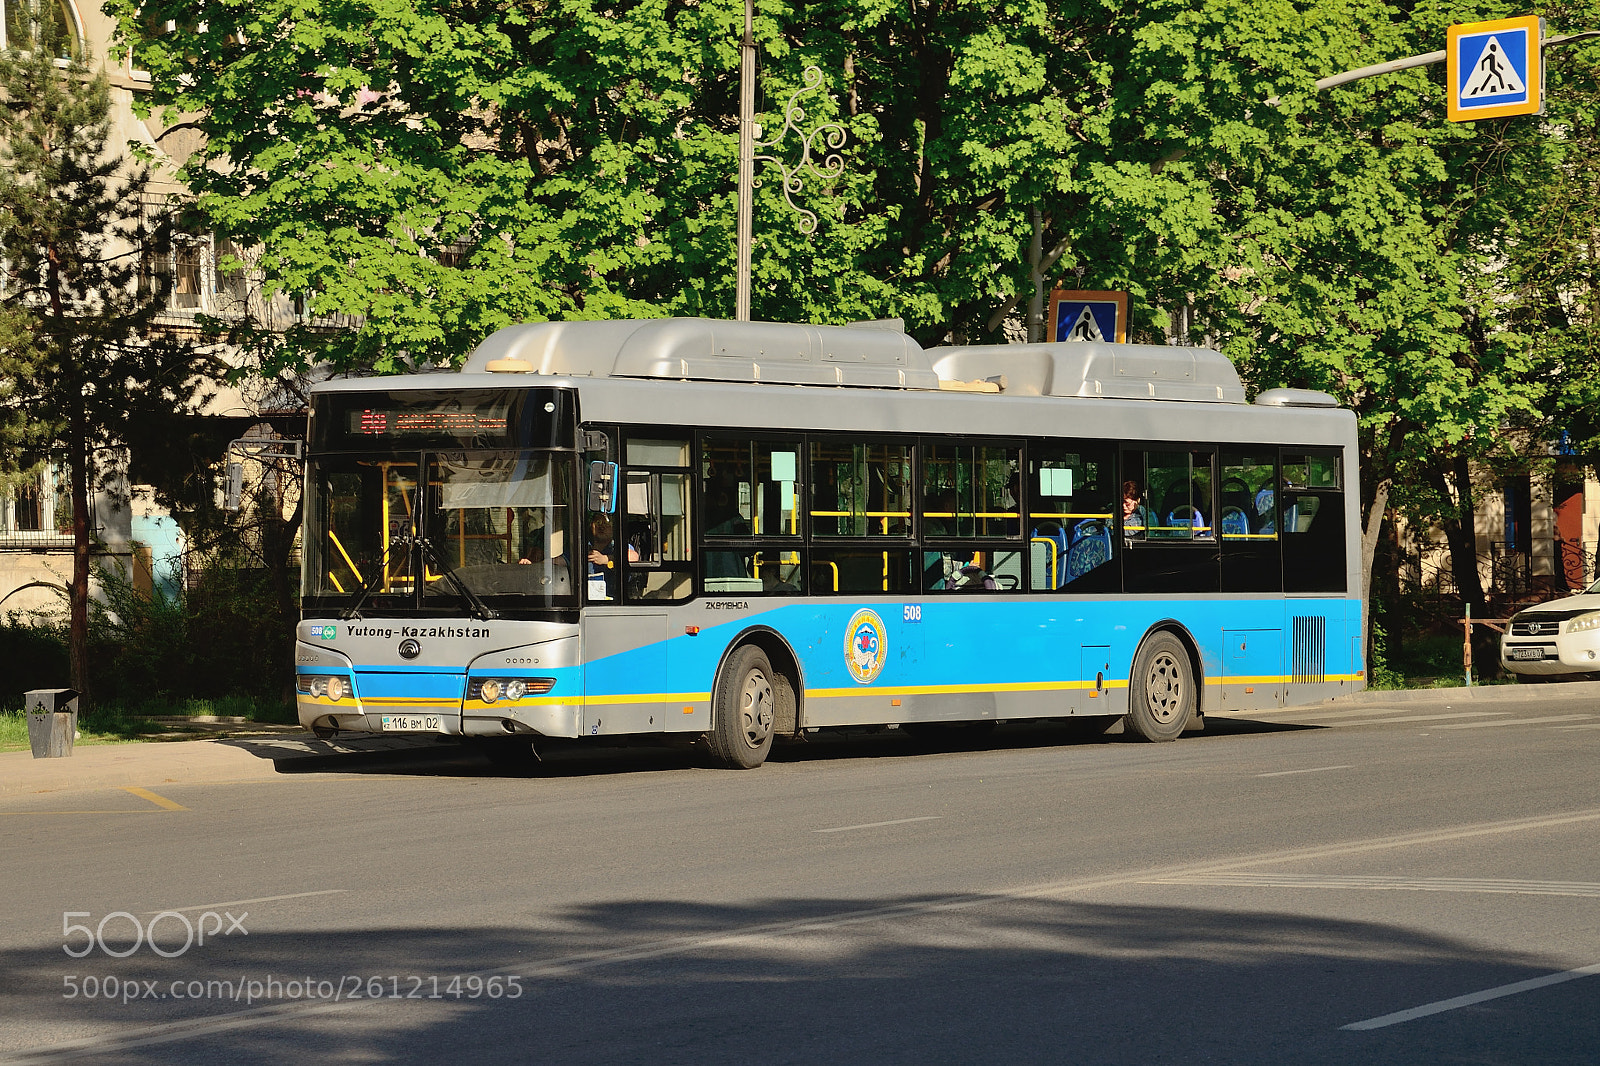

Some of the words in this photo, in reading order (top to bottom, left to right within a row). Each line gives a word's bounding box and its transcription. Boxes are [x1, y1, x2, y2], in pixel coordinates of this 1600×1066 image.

[903, 605, 922, 621] 508
[311, 626, 323, 635] 508
[347, 625, 490, 639] Yutong-Kazakhstan
[392, 717, 408, 729] 116
[410, 719, 422, 729] BM
[426, 717, 438, 729] 02
